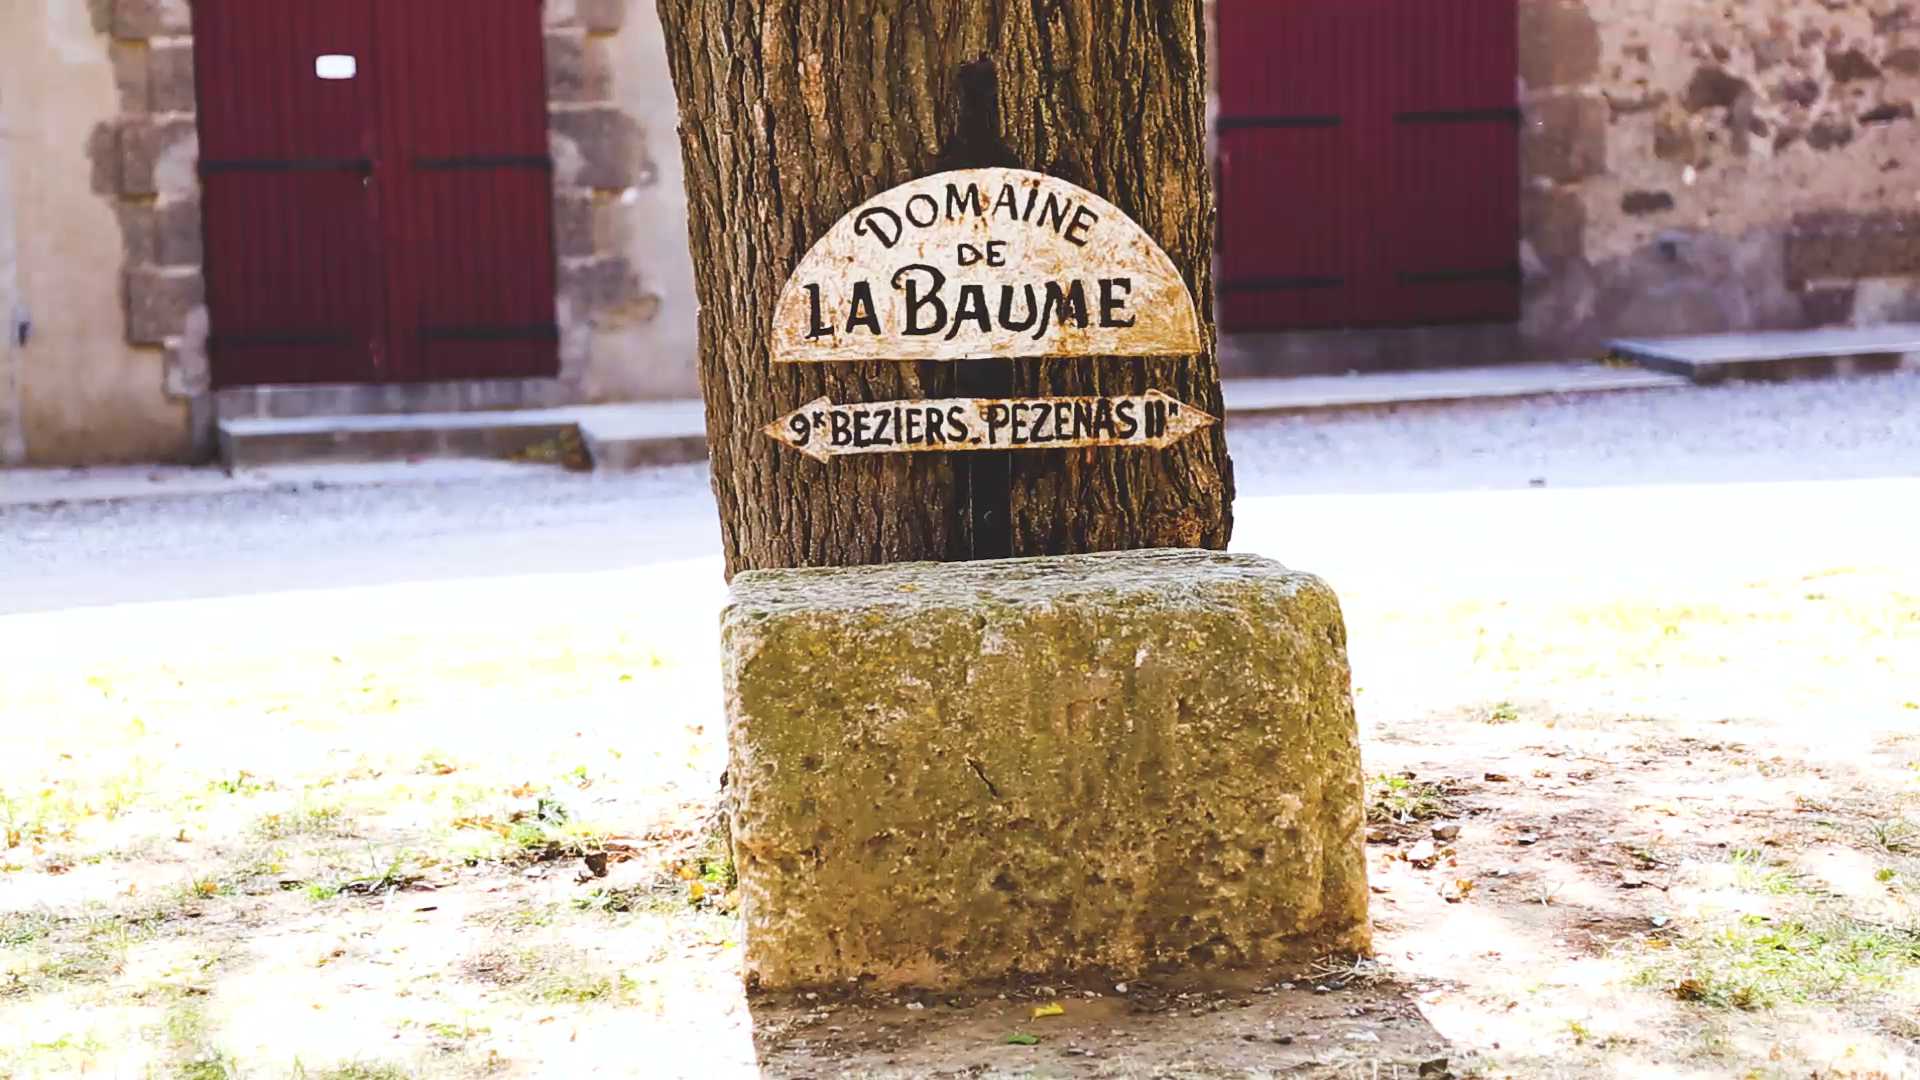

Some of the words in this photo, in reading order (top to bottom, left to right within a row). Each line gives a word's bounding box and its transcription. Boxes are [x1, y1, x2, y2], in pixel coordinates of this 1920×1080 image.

[957, 240, 1007, 267] DE
[803, 281, 882, 339] LA
[891, 264, 1136, 341] BAUME
[987, 402, 1138, 445] PEZENAS
